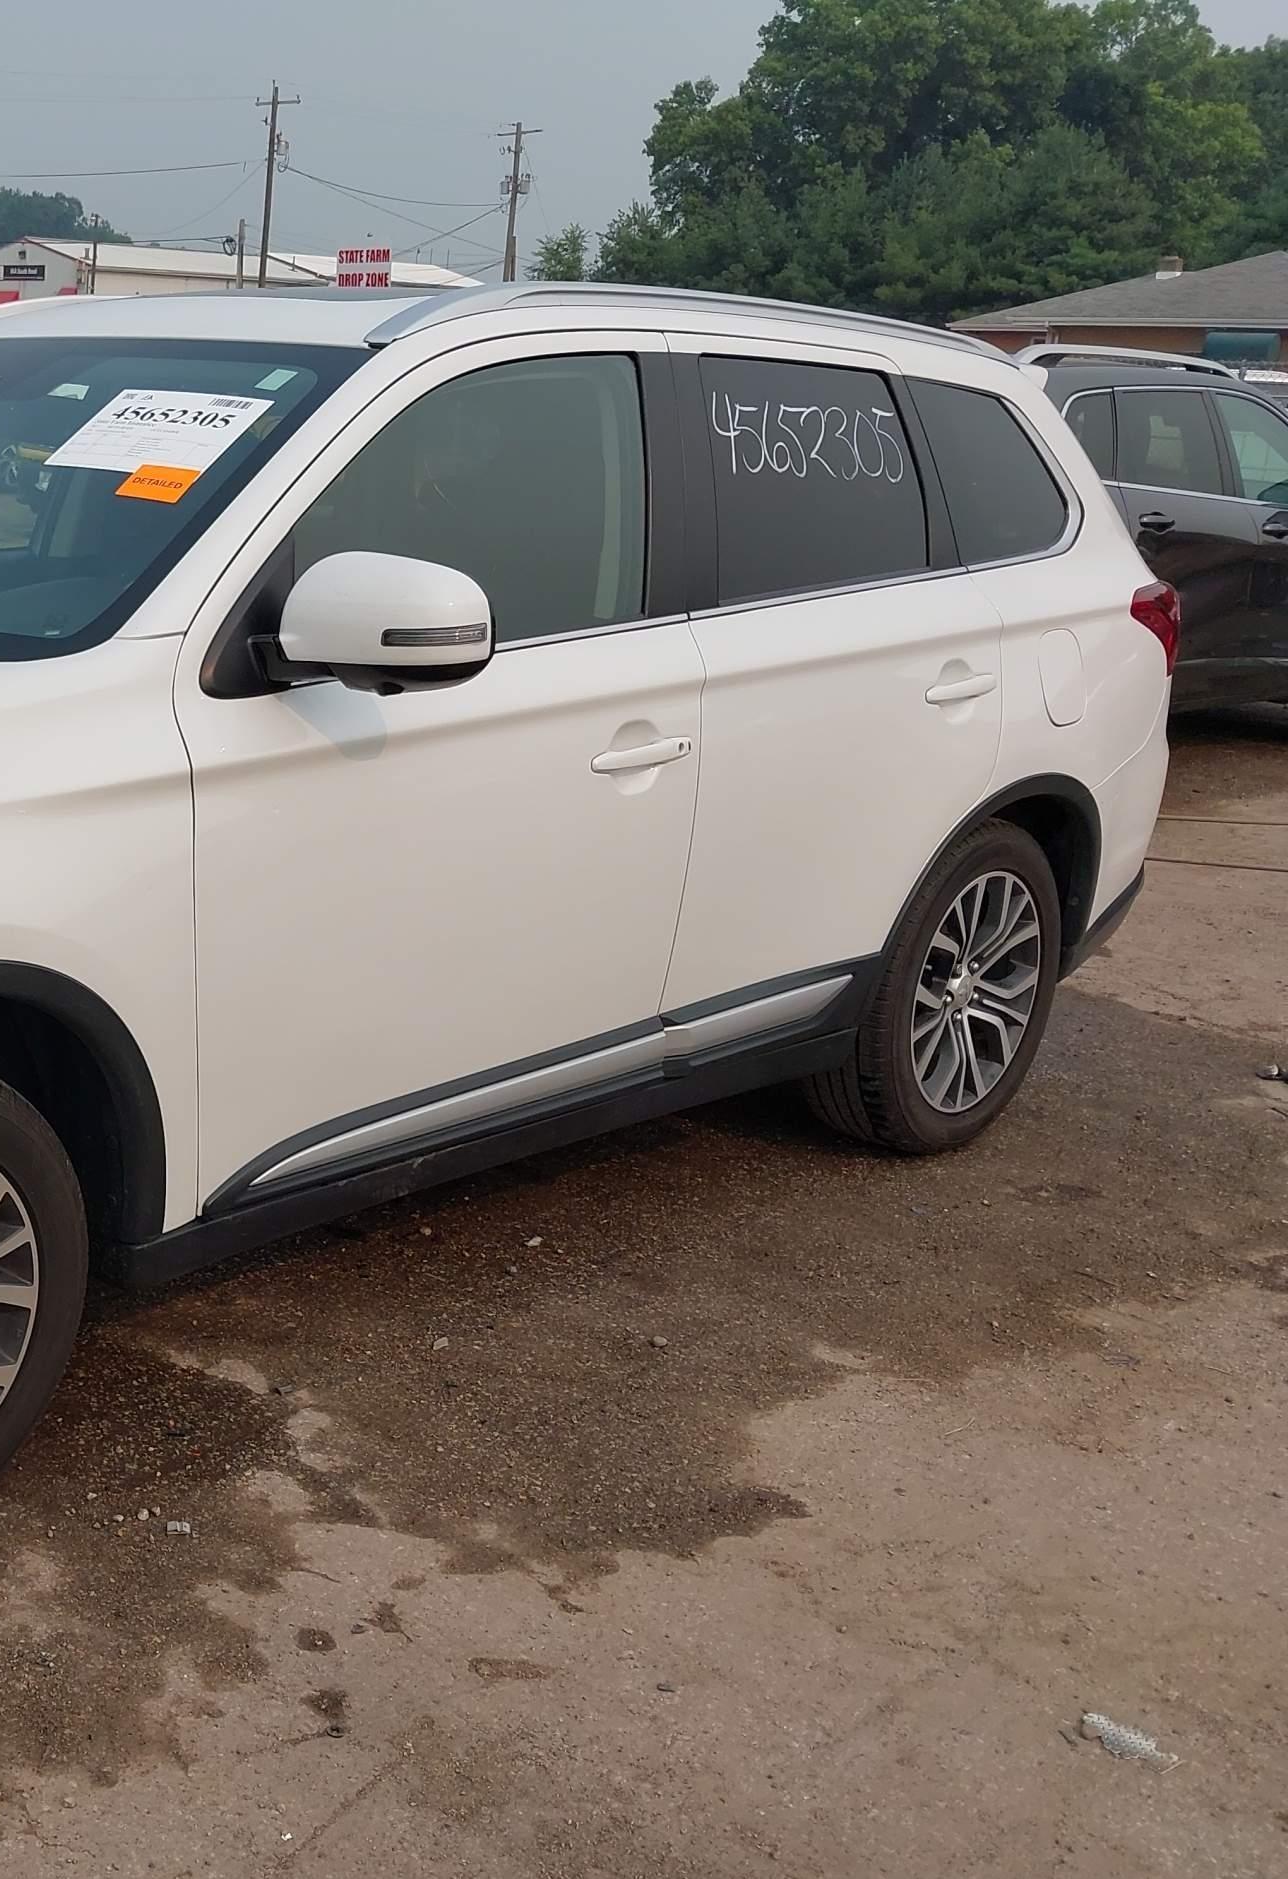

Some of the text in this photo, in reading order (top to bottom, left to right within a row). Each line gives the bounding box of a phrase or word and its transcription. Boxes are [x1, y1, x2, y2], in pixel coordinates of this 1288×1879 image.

[338, 248, 390, 264] STATE FARM
[338, 272, 389, 288] DROP ZONE
[112, 405, 237, 429] 45652305
[712, 391, 904, 483] 45652305
[132, 477, 183, 489] DETAILED
